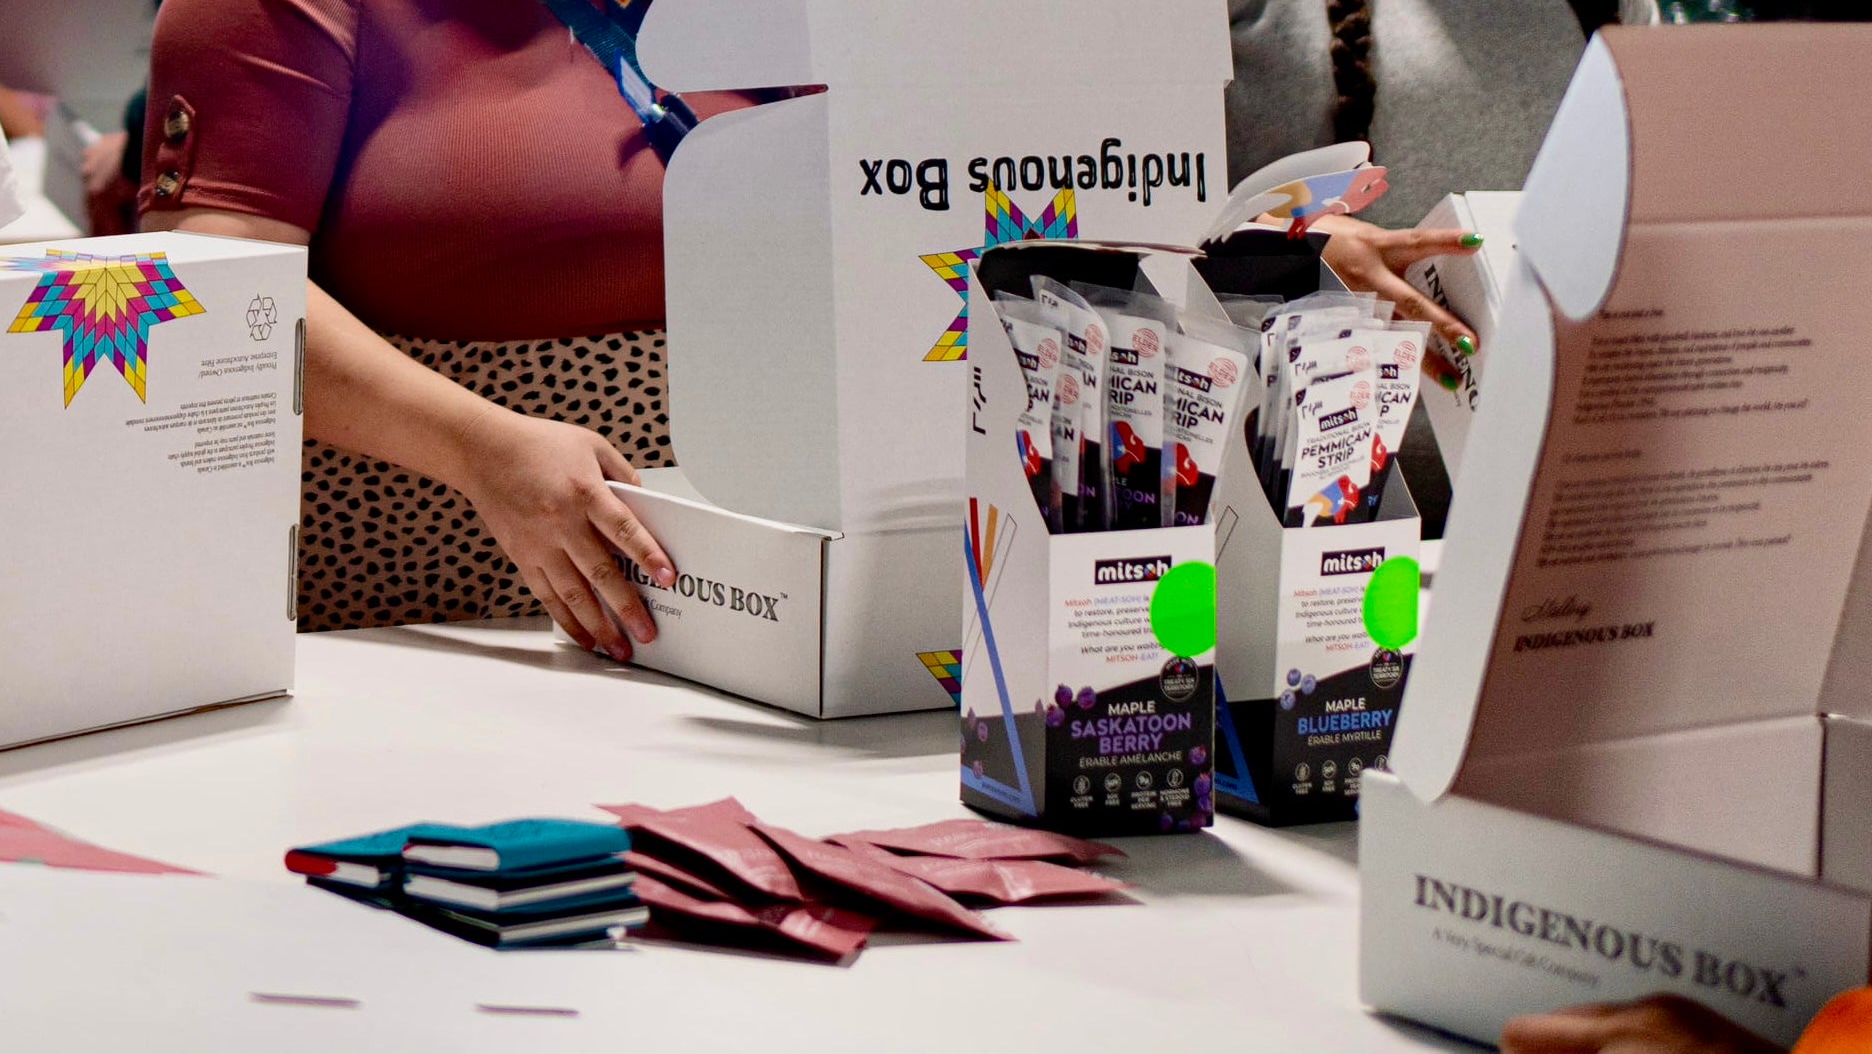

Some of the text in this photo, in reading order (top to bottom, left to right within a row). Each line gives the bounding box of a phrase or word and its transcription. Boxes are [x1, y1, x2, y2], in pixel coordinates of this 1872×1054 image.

[859, 137, 1206, 210] Indigenous Box
[1301, 428, 1372, 460] PEMMICAN
[1318, 447, 1355, 469] STRIP
[651, 601, 683, 620] Company
[1114, 617, 1142, 626] culture
[1513, 620, 1656, 653] INDIGENOUS BOX
[1108, 700, 1156, 716] MAPLE
[1326, 698, 1367, 712] MAPLE
[1070, 712, 1191, 739] SASKATOON
[1297, 709, 1393, 735] BLUEBERRY
[1099, 732, 1163, 754] BERRY
[1342, 730, 1383, 742] MYRTILLE
[1412, 873, 1788, 1009] INDIGENOUS BOX
